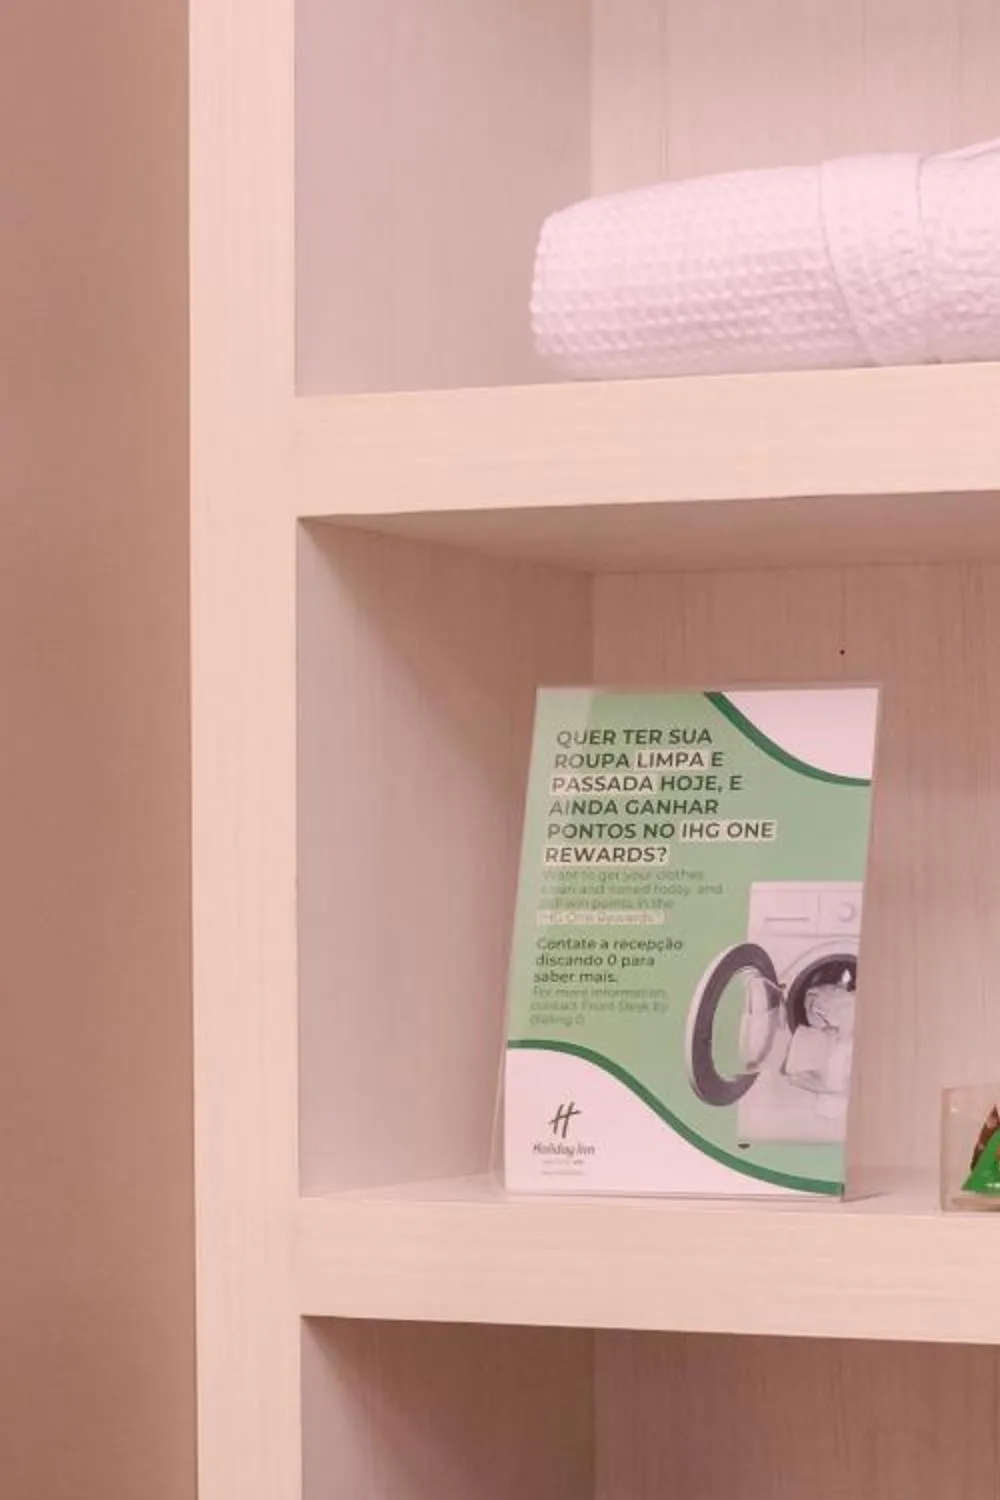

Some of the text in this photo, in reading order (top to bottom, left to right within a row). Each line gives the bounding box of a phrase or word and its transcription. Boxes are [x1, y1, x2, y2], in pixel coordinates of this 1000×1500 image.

[556, 728, 713, 747] QUER TER SUA
[554, 751, 724, 769] ROUPA LIMPA E
[551, 775, 743, 794] PASSADA HOJE, E
[548, 799, 719, 817] AINDA GANHAR
[547, 821, 773, 840] PONTOS NO IHG ONE
[544, 846, 667, 864] REWARDS?
[535, 937, 683, 952] Contate a recepção
[535, 953, 655, 968] discando 0 para
[533, 969, 618, 983] saber mais.
